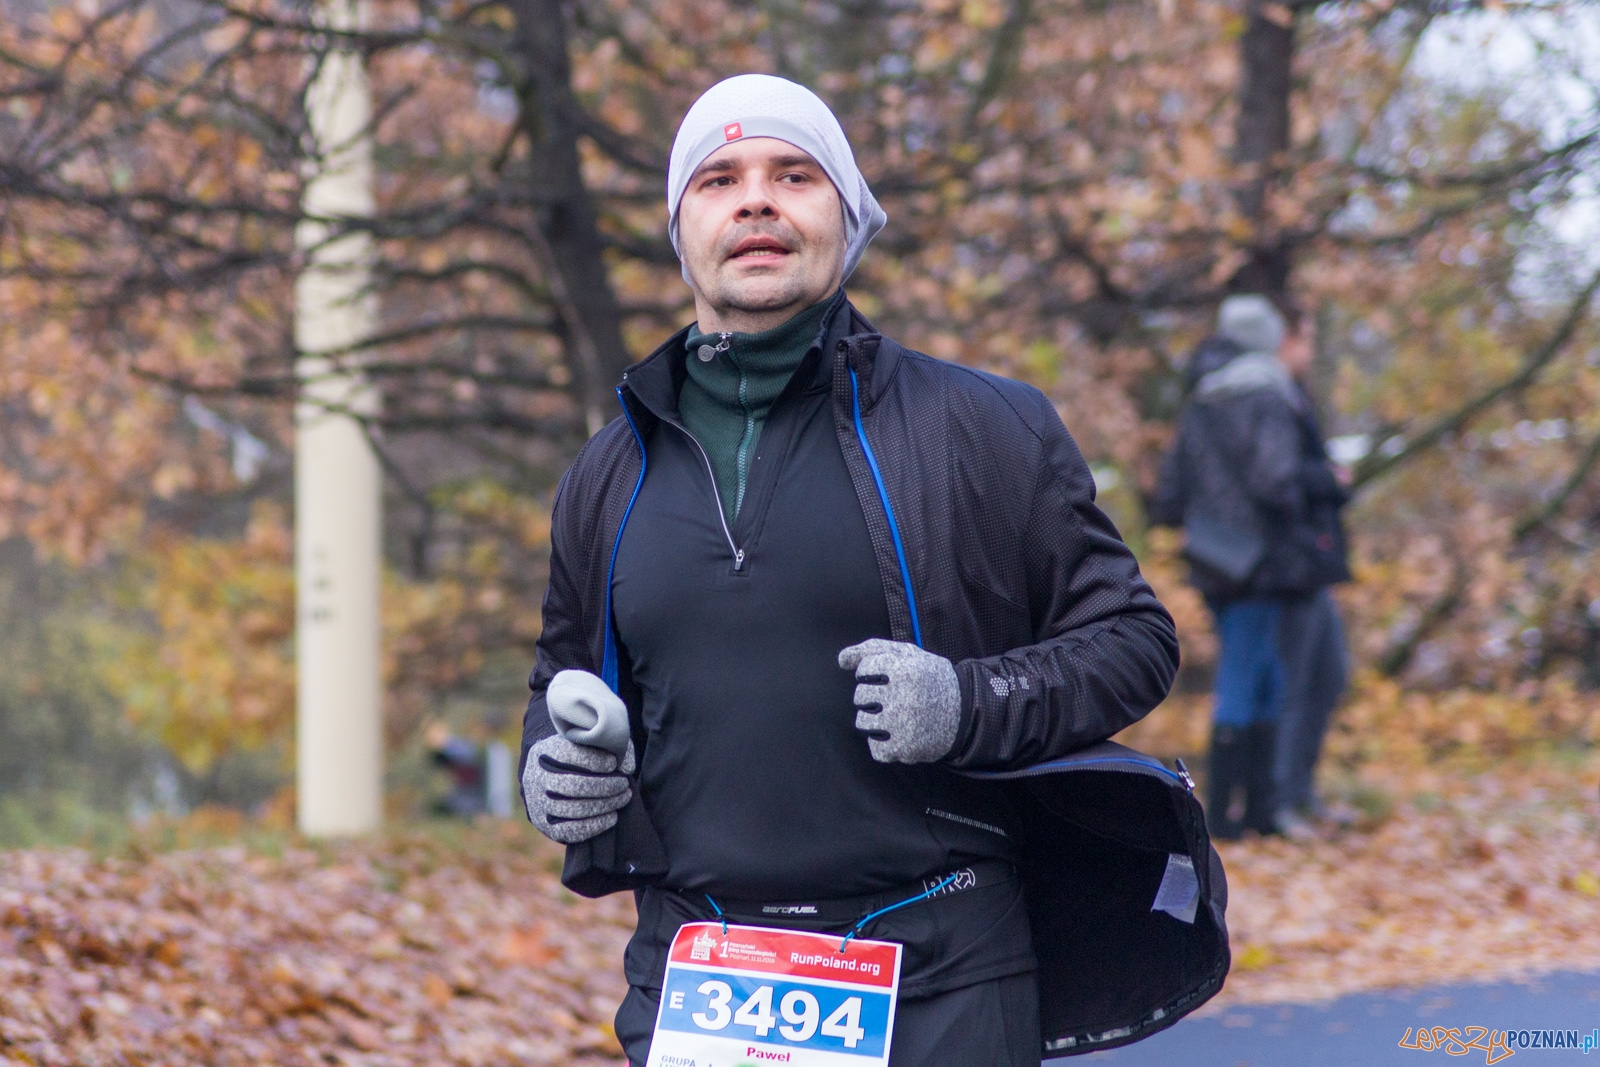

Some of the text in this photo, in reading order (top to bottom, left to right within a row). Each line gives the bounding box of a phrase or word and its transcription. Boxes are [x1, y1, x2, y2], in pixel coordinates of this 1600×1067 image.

[719, 941, 729, 958] 1
[790, 952, 880, 975] RunPoland.org
[669, 980, 865, 1049] E 3494
